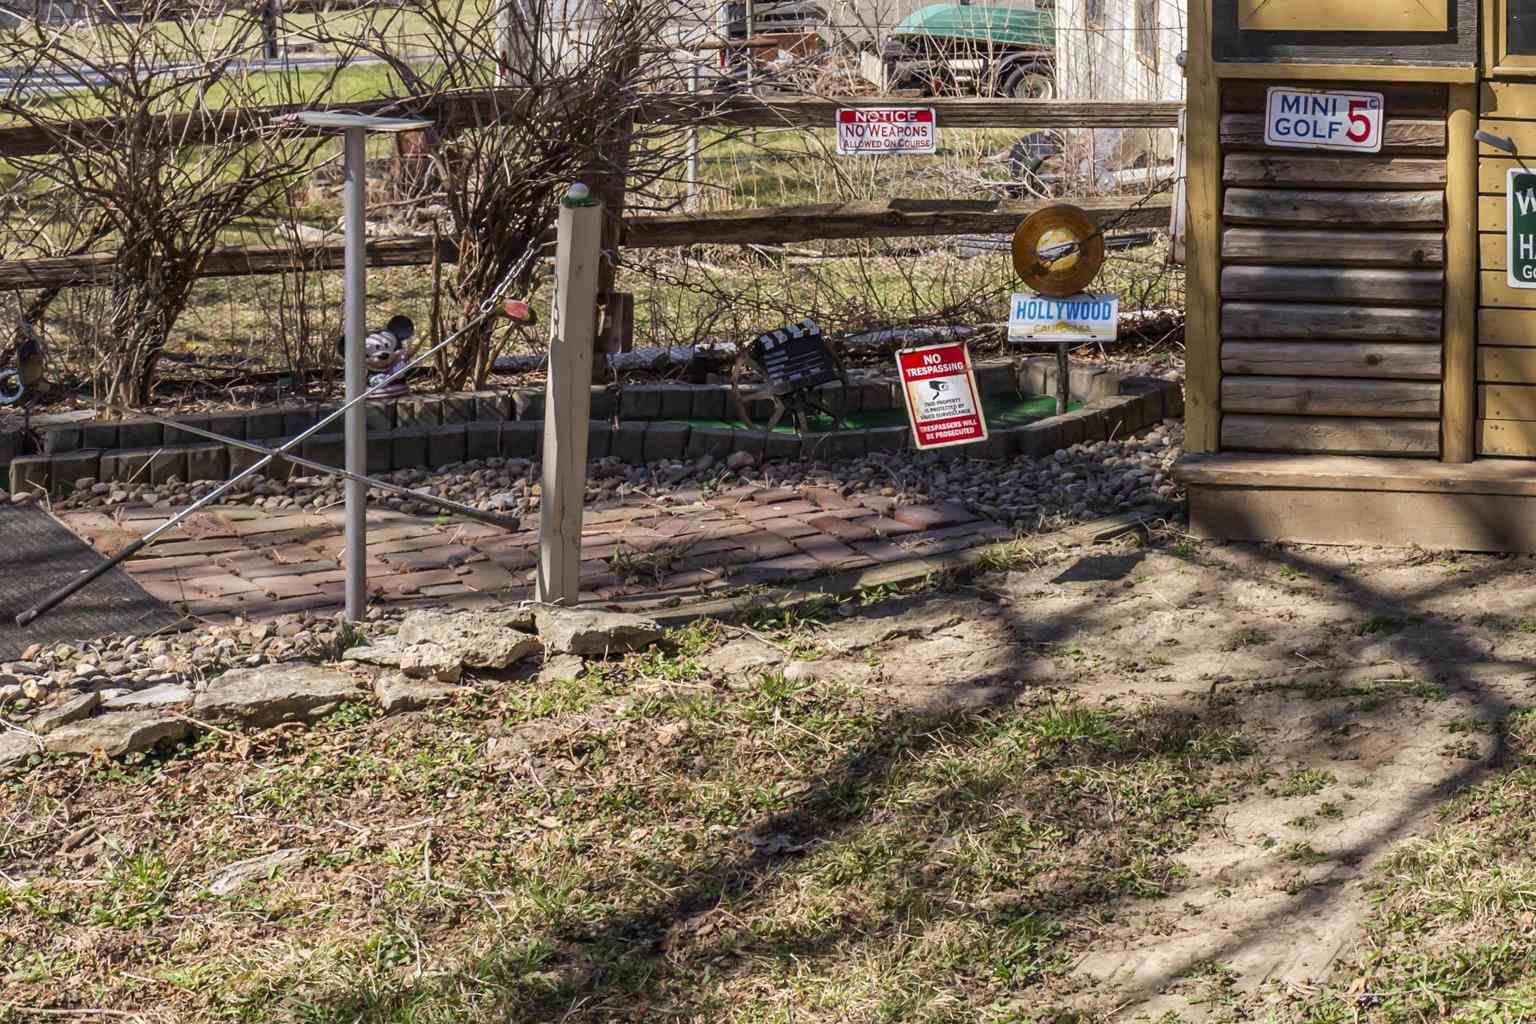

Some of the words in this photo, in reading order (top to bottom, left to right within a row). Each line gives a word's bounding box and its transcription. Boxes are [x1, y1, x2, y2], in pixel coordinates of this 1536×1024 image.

[1281, 95, 1337, 117] MINI
[855, 111, 918, 122] NOTICE
[845, 124, 865, 137] NO
[868, 124, 928, 137] WEAPONS
[1275, 118, 1343, 139] GOLF
[843, 139, 882, 149] ALLOWED
[884, 138, 896, 148] ON
[897, 138, 930, 148] COURSE
[1016, 301, 1112, 321] HOLLYWOOD
[923, 353, 942, 365] NO
[906, 362, 964, 377] TRESPASSING
